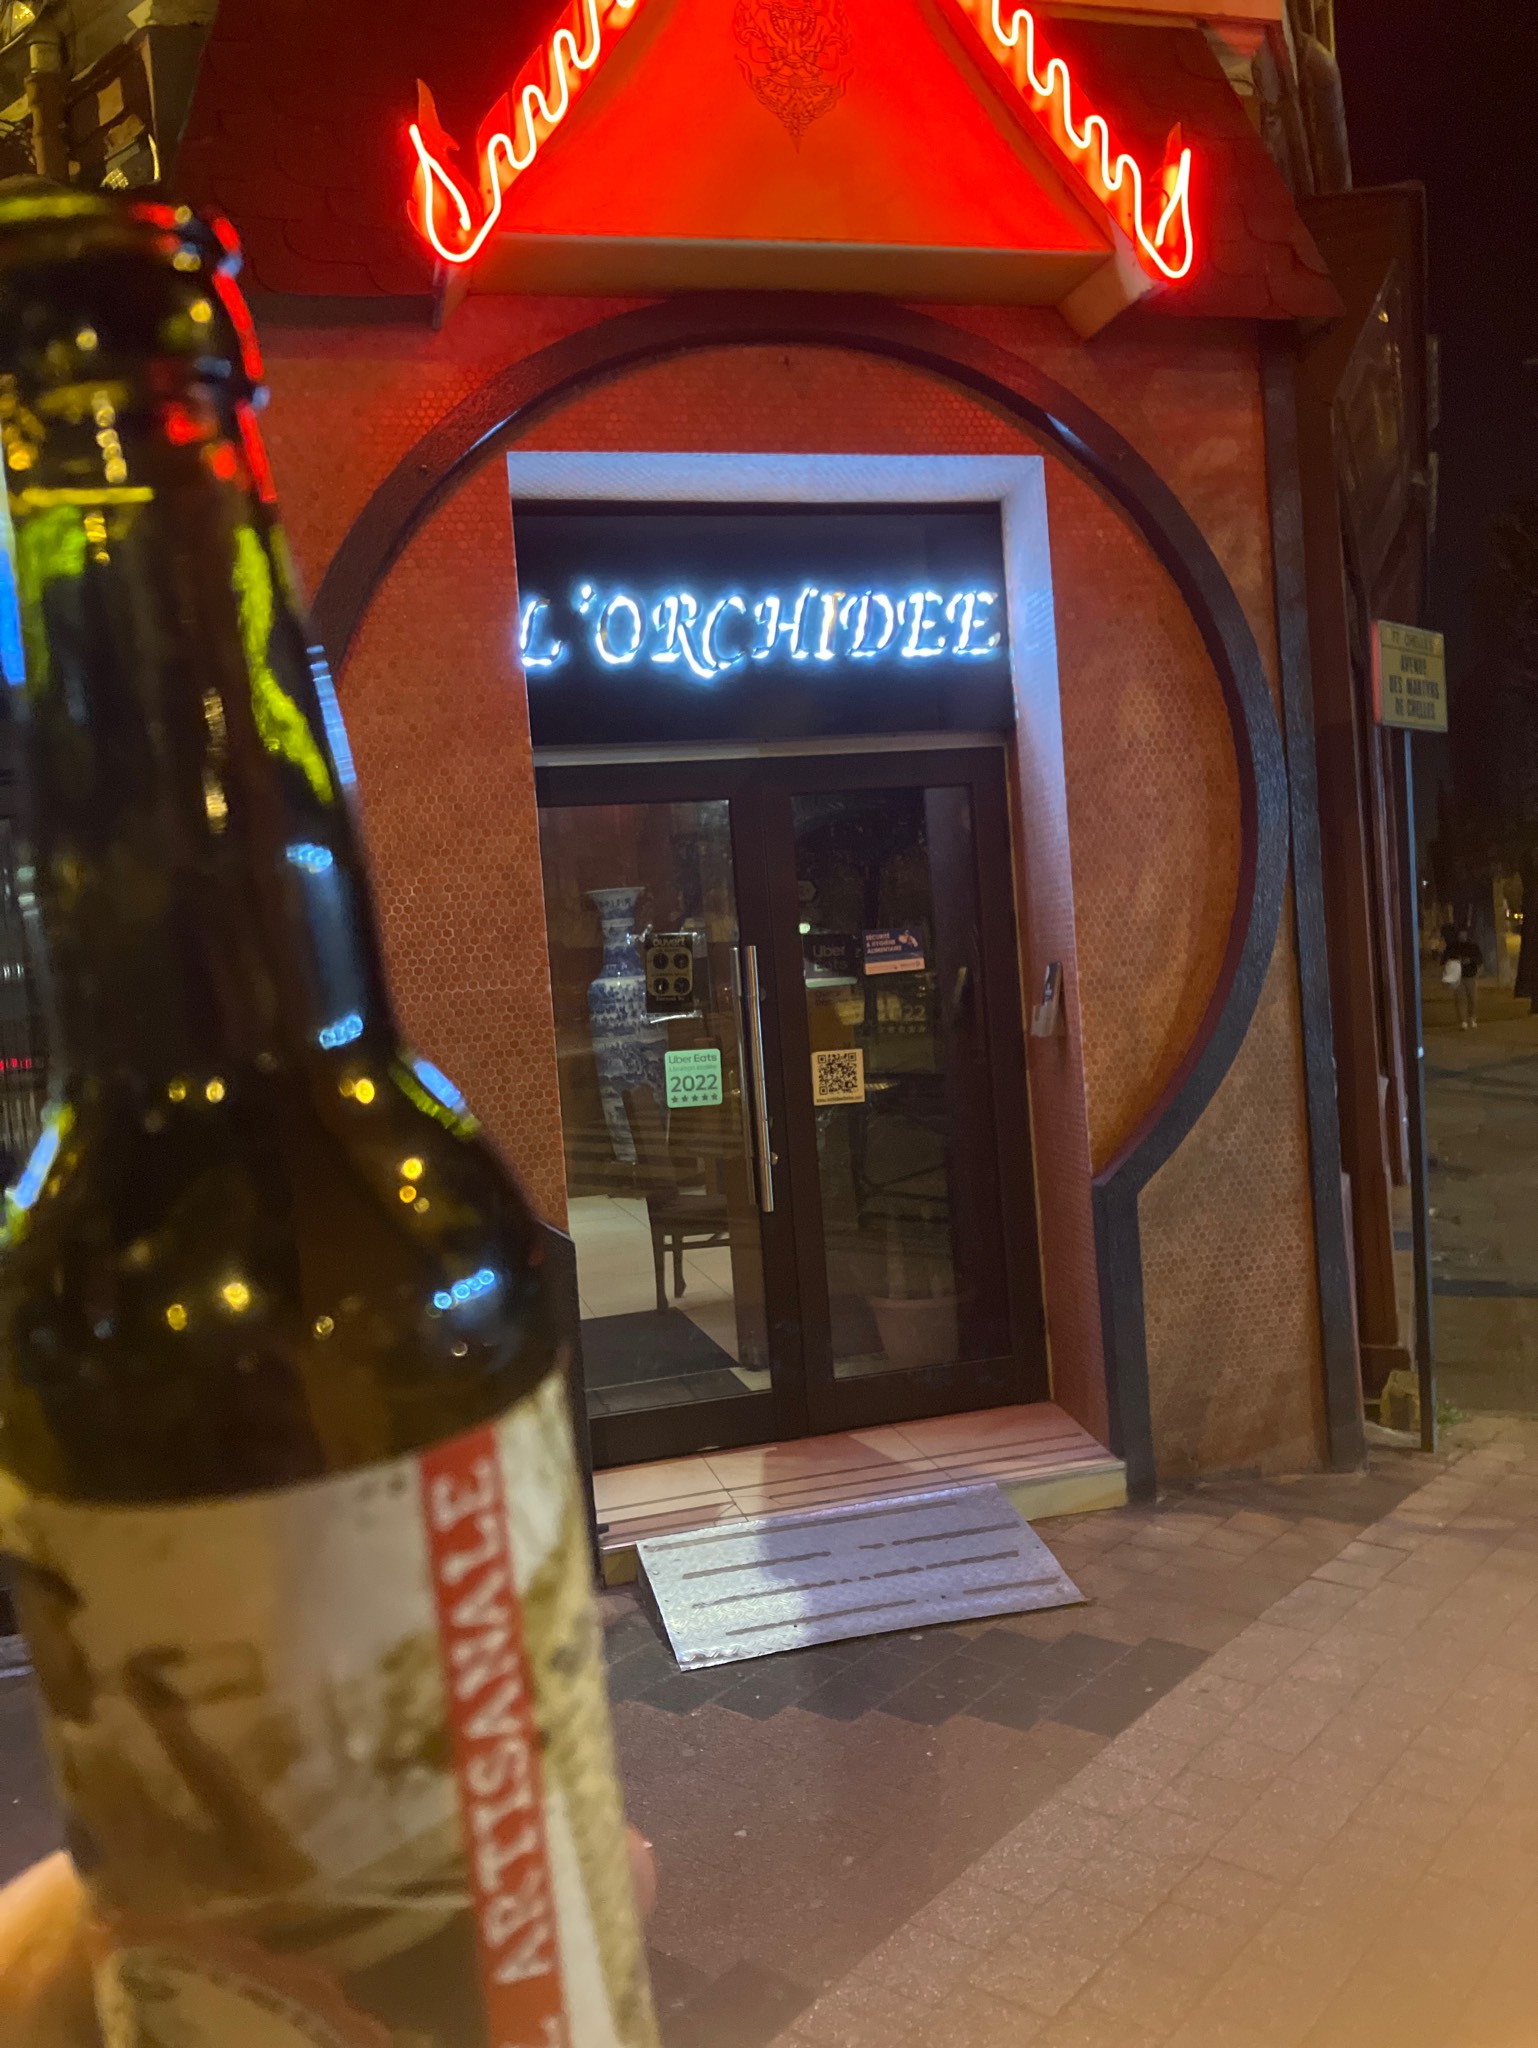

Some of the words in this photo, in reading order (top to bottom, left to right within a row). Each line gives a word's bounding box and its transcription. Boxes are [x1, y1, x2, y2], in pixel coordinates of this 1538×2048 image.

[1401, 655, 1427, 675] AVENUE
[1389, 674, 1402, 693] DES
[1406, 677, 1439, 699] MARTYRS
[812, 944, 846, 958] Uber
[668, 1054, 692, 1064] Uber
[694, 1053, 718, 1063] Eats
[670, 1074, 718, 1093] 2022
[430, 1460, 553, 1986] ARTISANALE
